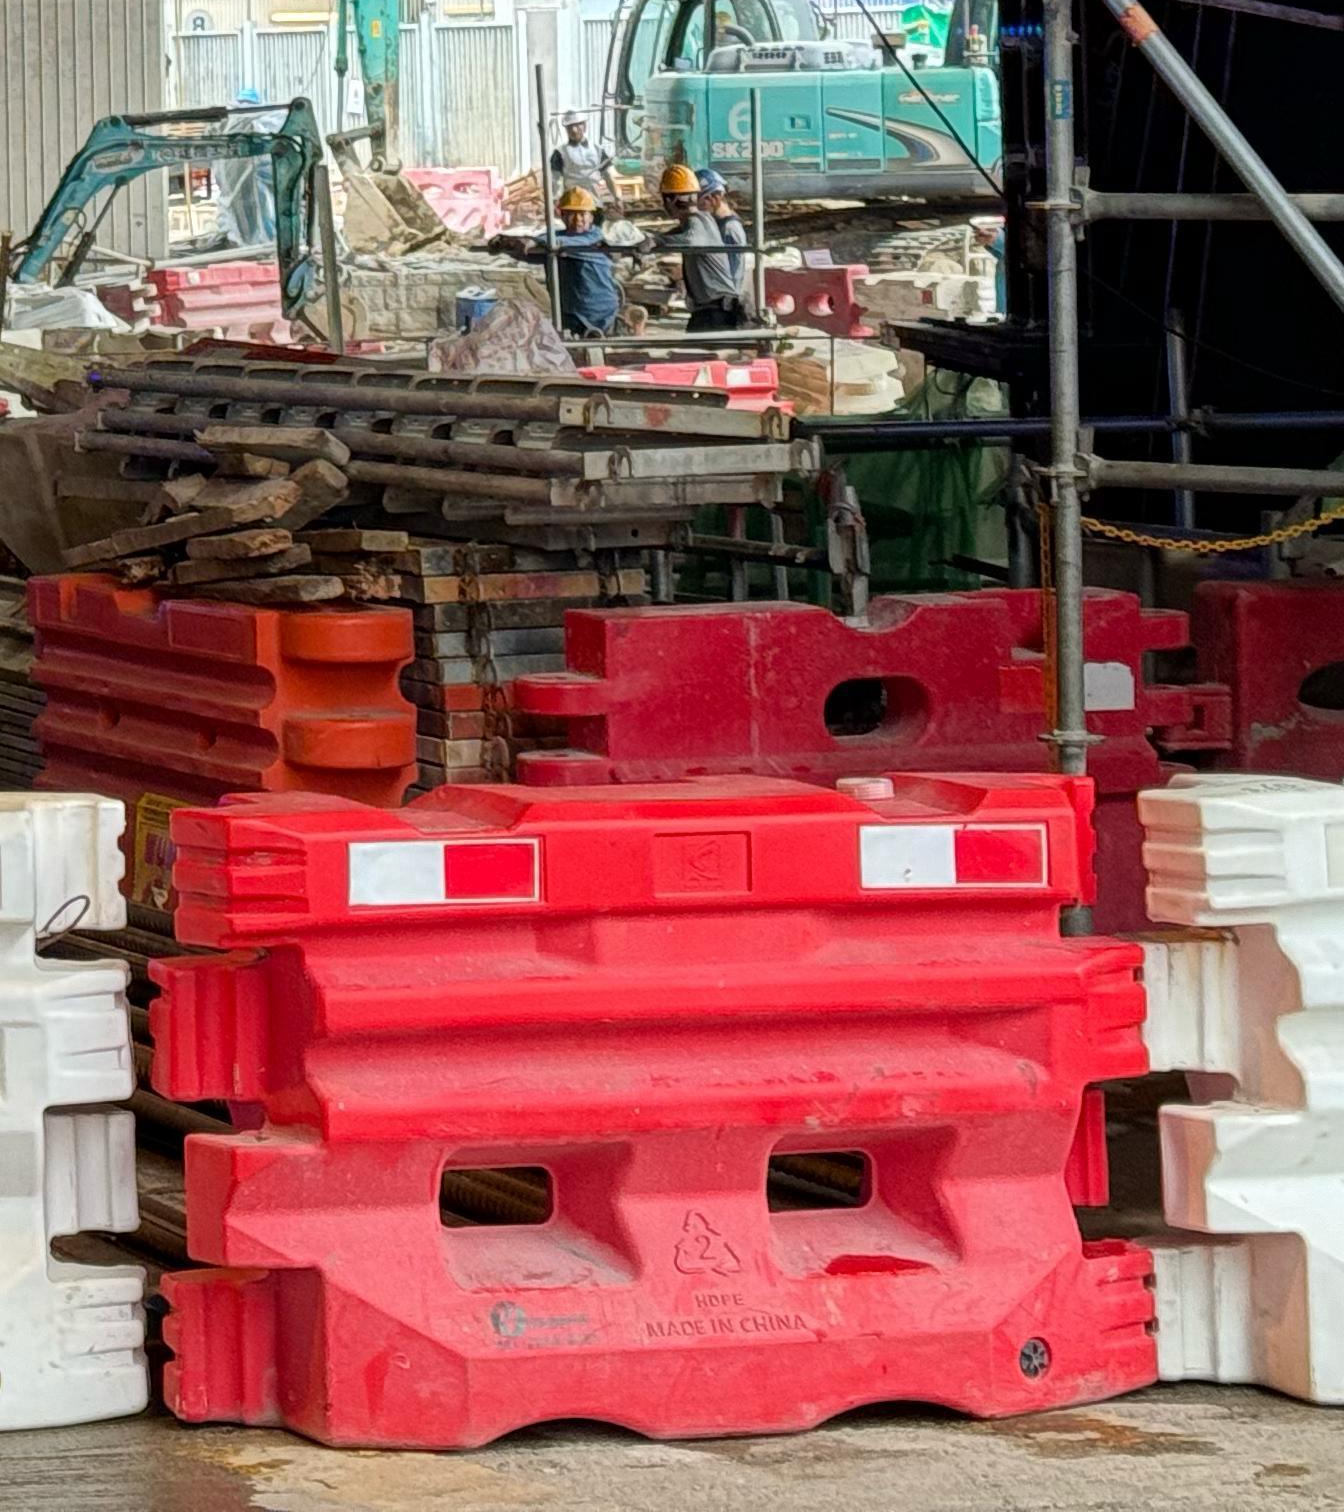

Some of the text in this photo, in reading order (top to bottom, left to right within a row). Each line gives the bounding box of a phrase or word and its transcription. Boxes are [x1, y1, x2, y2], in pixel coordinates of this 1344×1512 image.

[695, 1235, 717, 1260] 2
[646, 1313, 809, 1339] MADE IN CHINA
